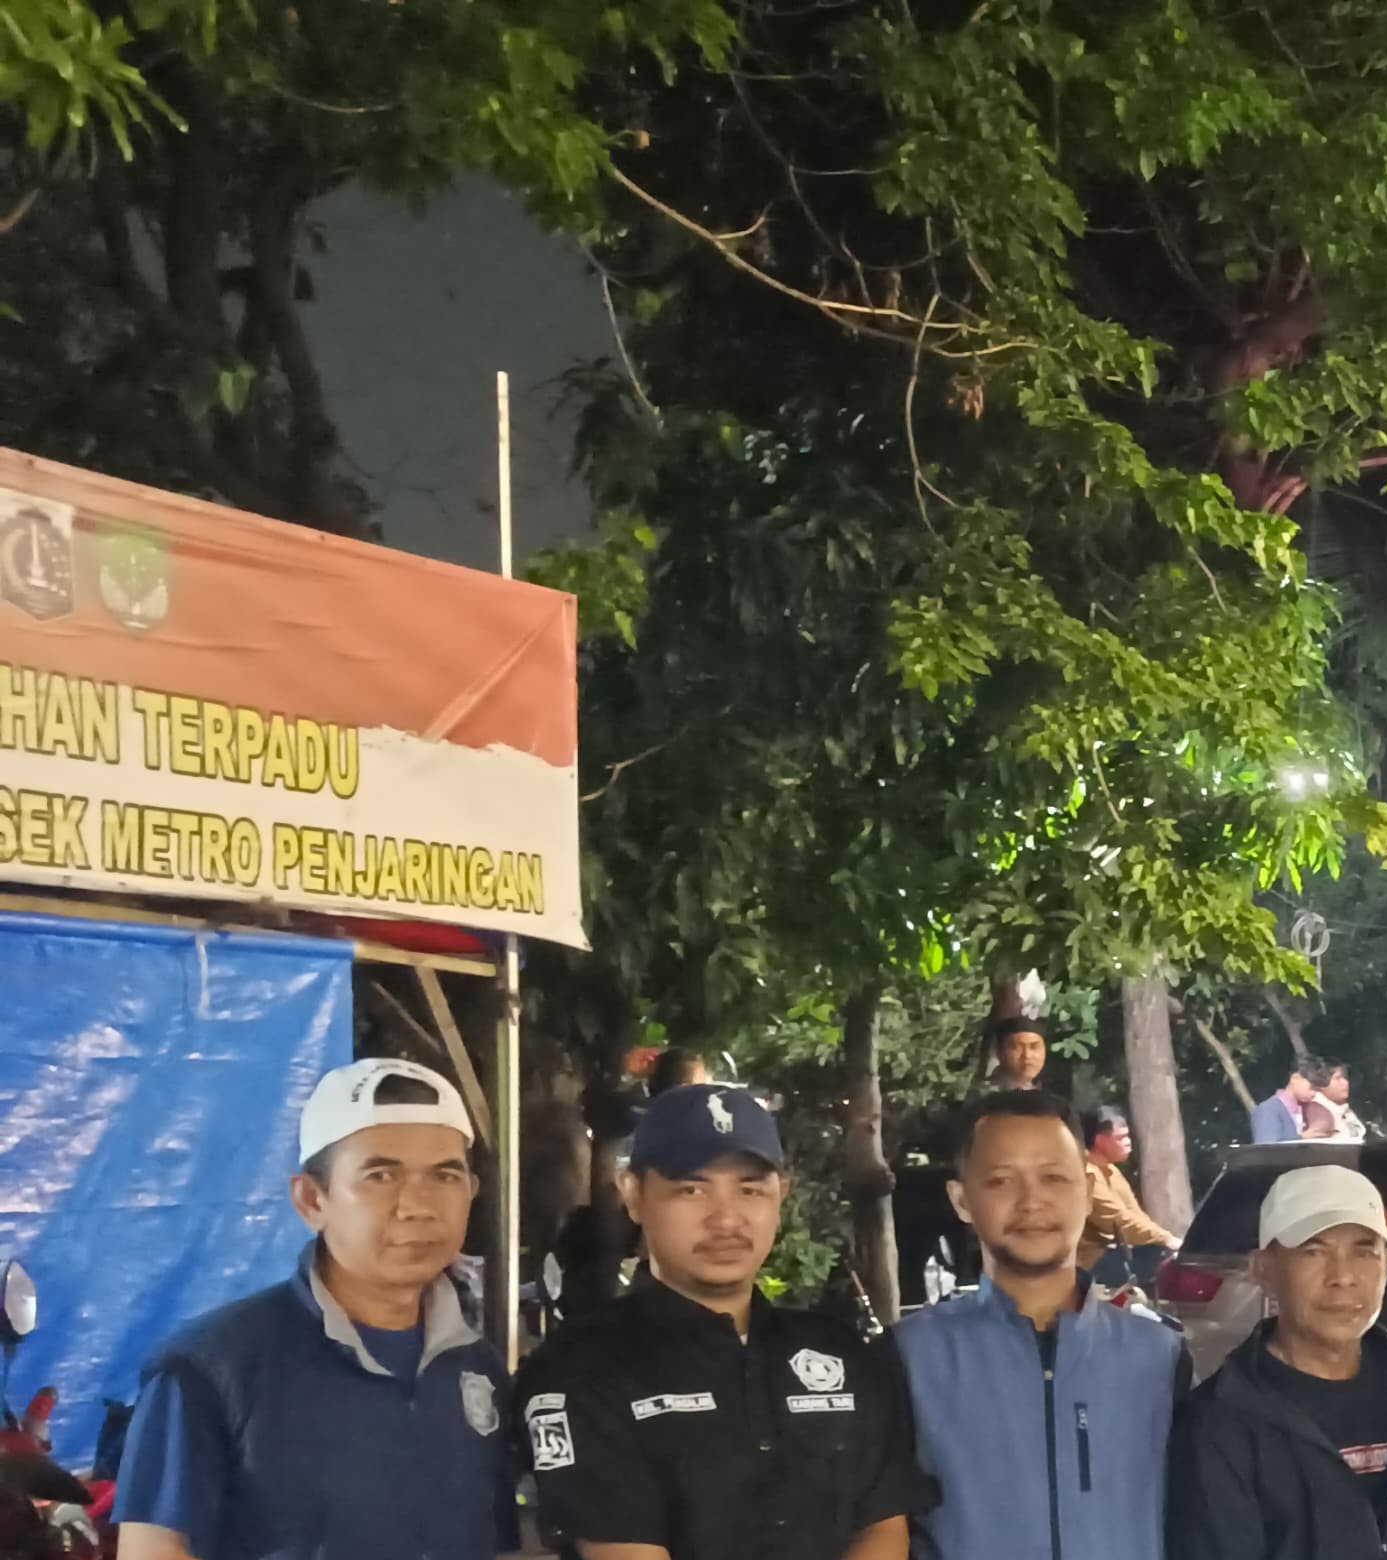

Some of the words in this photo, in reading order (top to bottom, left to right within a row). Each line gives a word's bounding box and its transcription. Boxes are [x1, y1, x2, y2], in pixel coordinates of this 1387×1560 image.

[0, 661, 120, 765] HAN
[132, 685, 361, 799] TERPADU
[101, 800, 262, 887] METRO
[272, 822, 545, 915] PENJARINGAN
